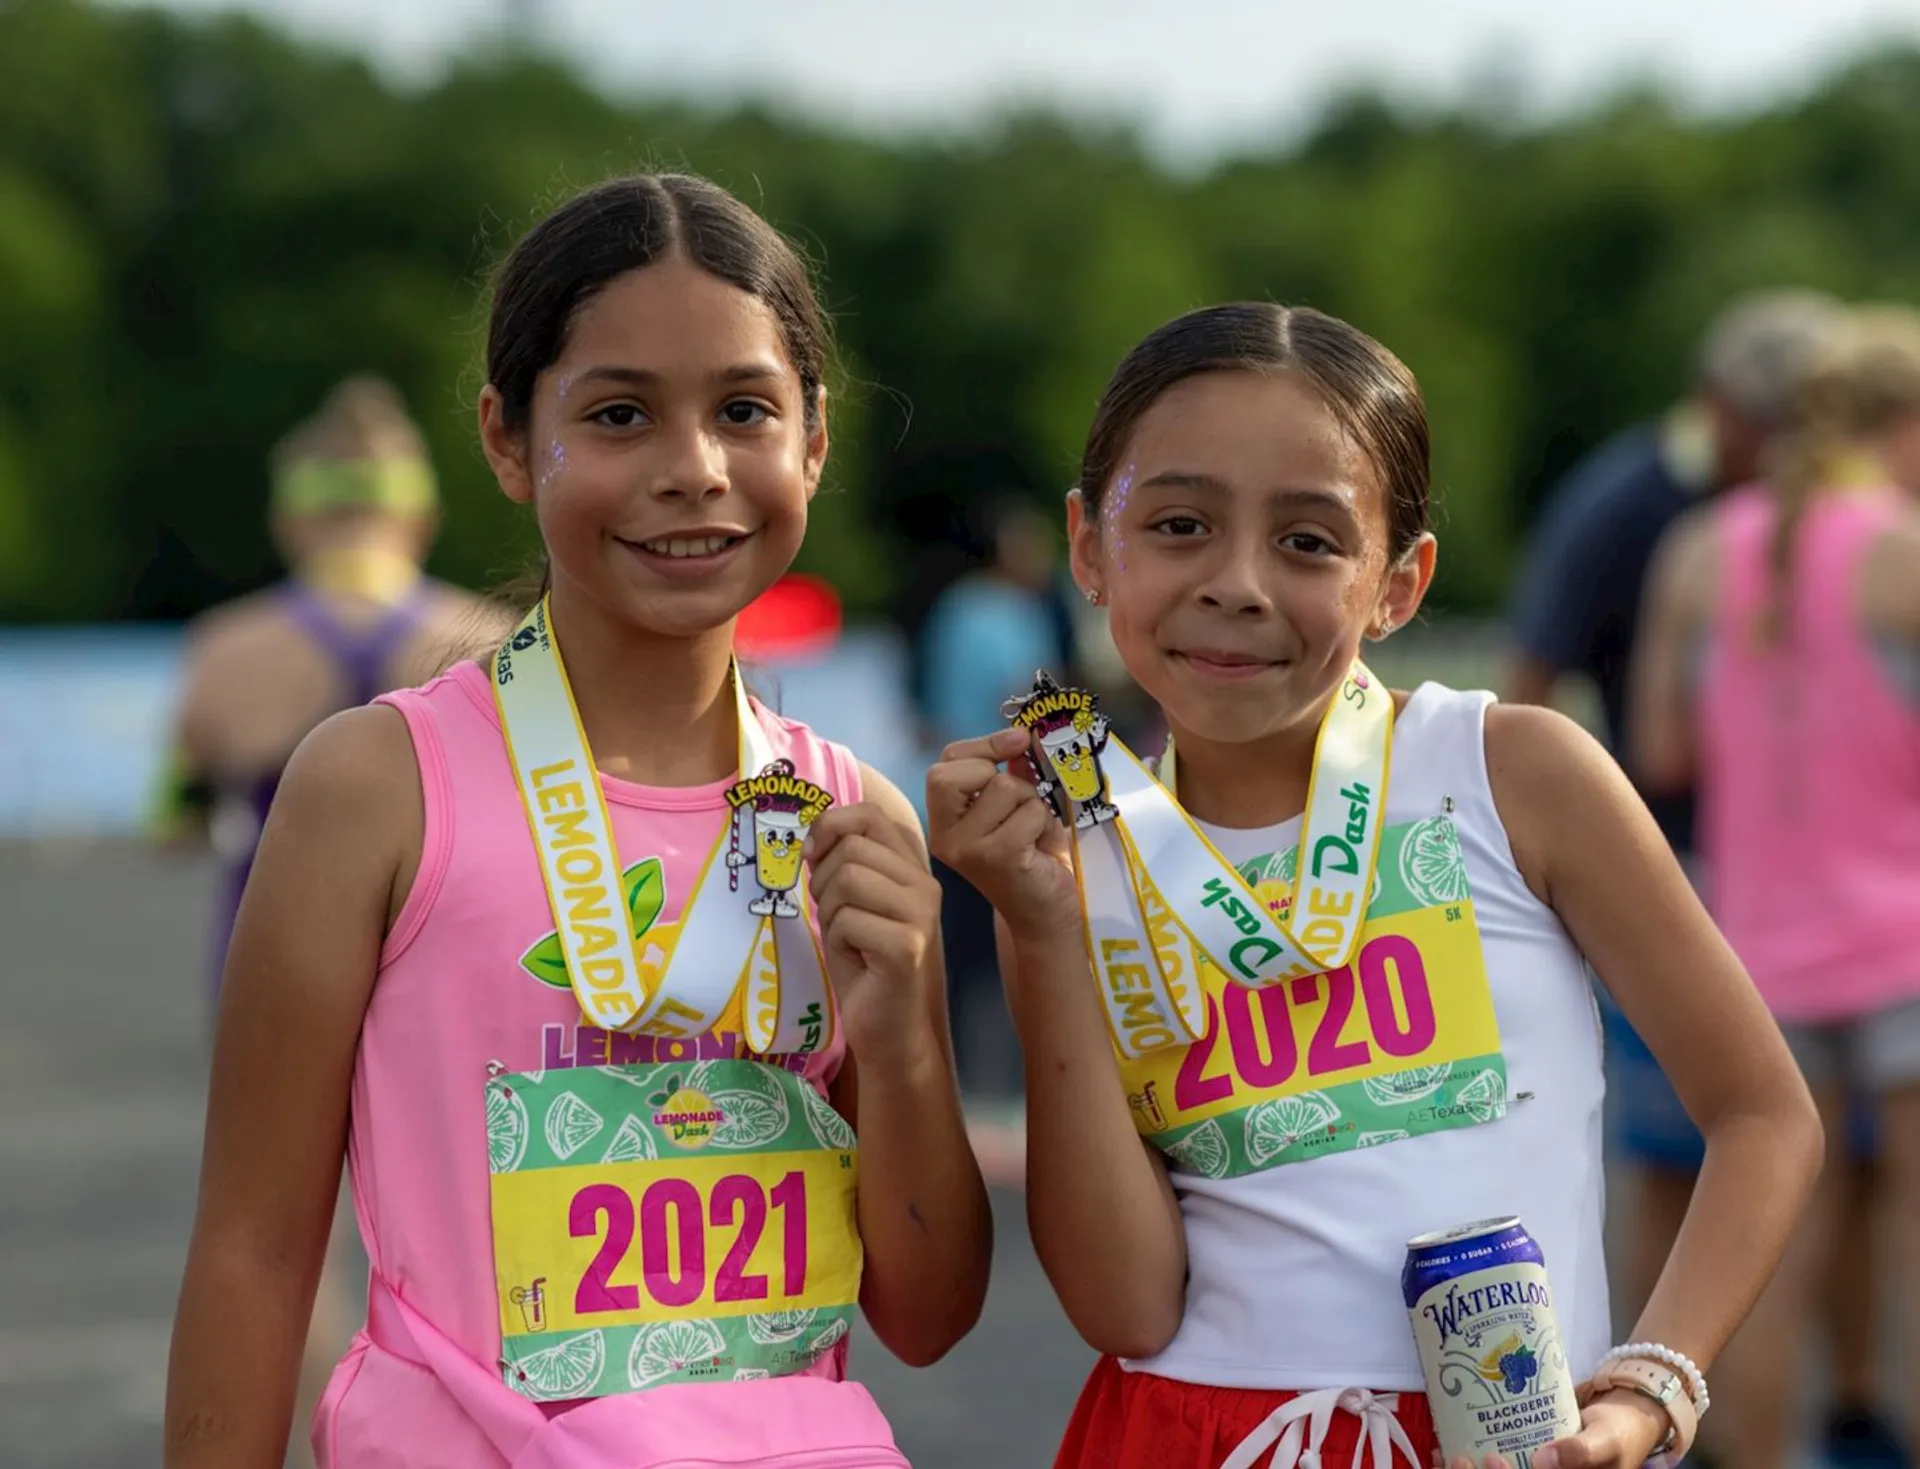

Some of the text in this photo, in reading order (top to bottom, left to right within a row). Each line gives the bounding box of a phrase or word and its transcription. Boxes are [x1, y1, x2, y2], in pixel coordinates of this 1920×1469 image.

[498, 638, 513, 686] exas
[1014, 692, 1092, 728] EMONADE
[726, 776, 834, 808] LEMONADE
[1312, 782, 1371, 878] Dash
[529, 758, 637, 1019] LEMONADE
[1199, 877, 1285, 979] Dash
[1445, 906, 1463, 923] 5K
[1174, 934, 1437, 1112] 2020
[653, 1110, 725, 1126] LEMONADE
[671, 1122, 710, 1141] Dash
[568, 1170, 808, 1315] 2021
[1467, 1246, 1493, 1259] SUGAR
[1422, 1281, 1549, 1350] WATERLOO
[1477, 1393, 1556, 1422] BLACKBERRY
[1486, 1408, 1557, 1435] LEMONADE
